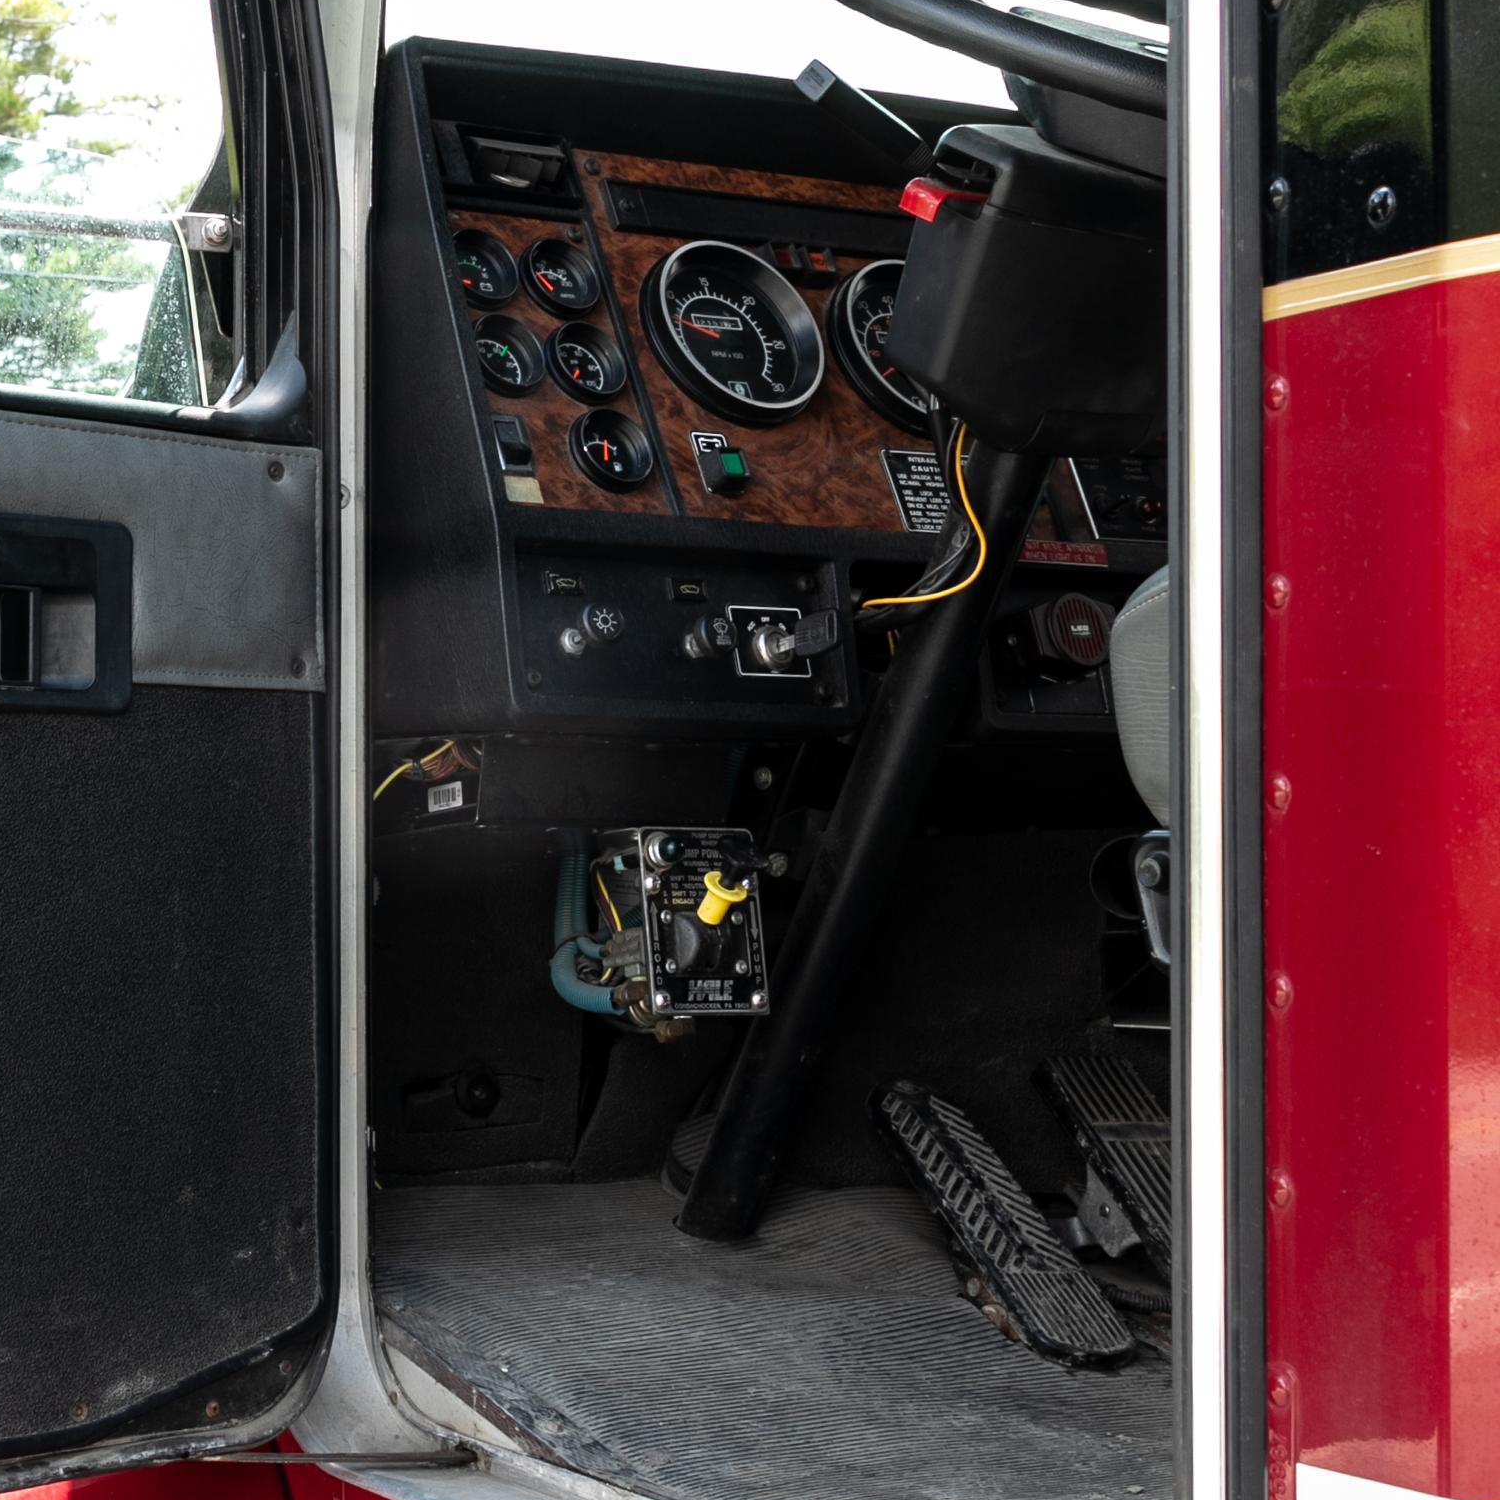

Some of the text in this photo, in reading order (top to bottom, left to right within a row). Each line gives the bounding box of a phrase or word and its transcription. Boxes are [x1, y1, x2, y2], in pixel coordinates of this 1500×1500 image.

[741, 296, 756, 306] 20
[772, 340, 787, 351] 25
[771, 382, 785, 393] 30
[653, 941, 664, 986] ROAD
[752, 941, 763, 986] PUMP
[687, 979, 734, 1001] HALE
